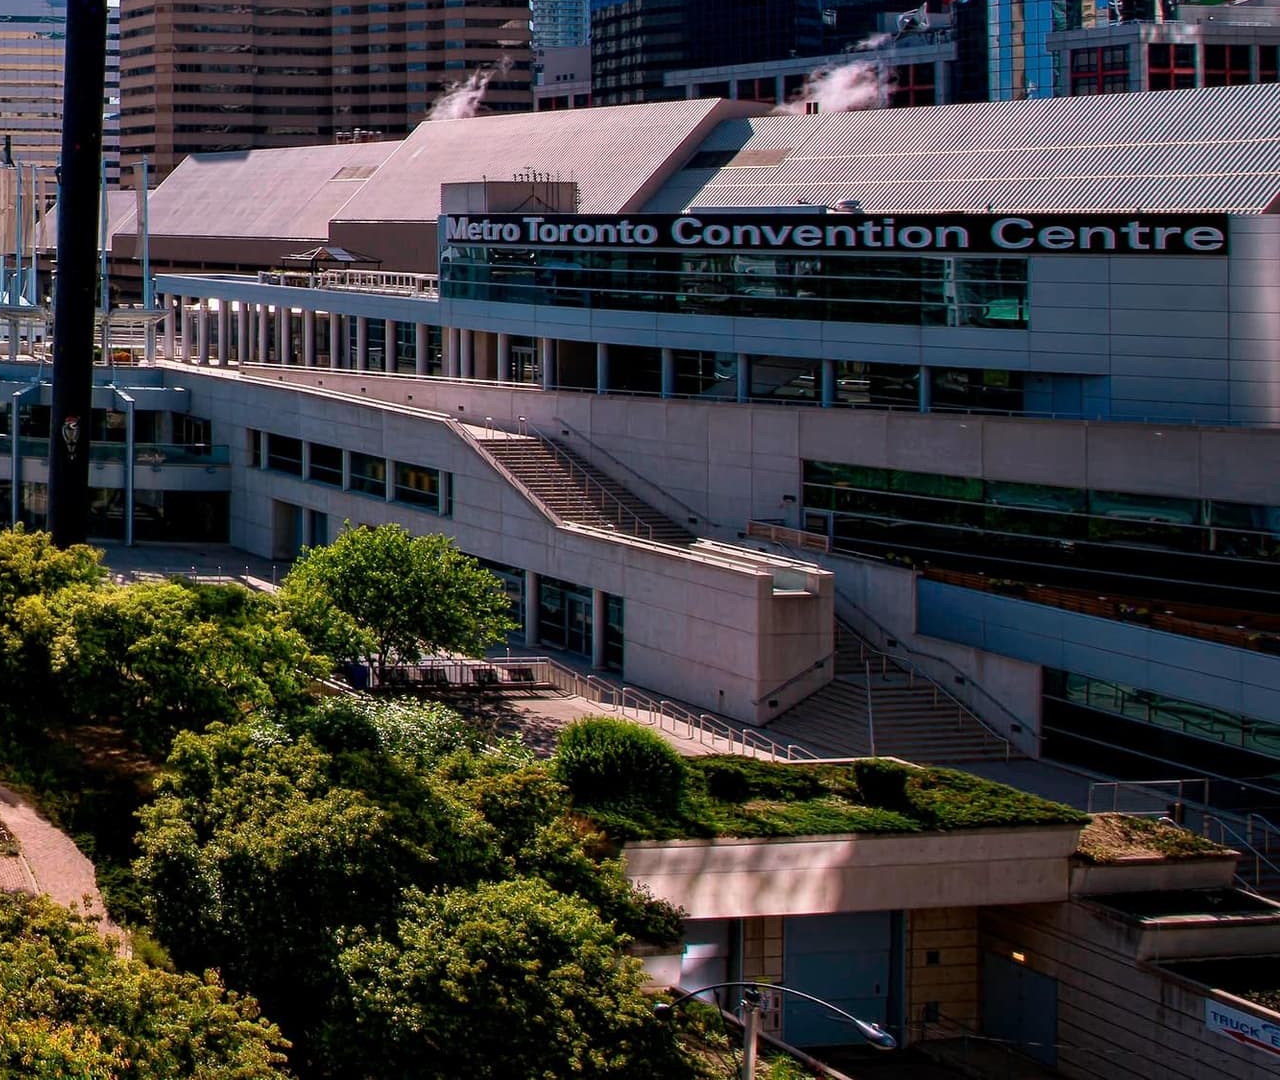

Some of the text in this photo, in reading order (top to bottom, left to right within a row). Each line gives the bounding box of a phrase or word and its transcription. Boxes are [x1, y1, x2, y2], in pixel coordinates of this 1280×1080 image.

[445, 216, 1225, 250] Metro Toronto Convention Centre
[1210, 1010, 1261, 1038] TRUCK
